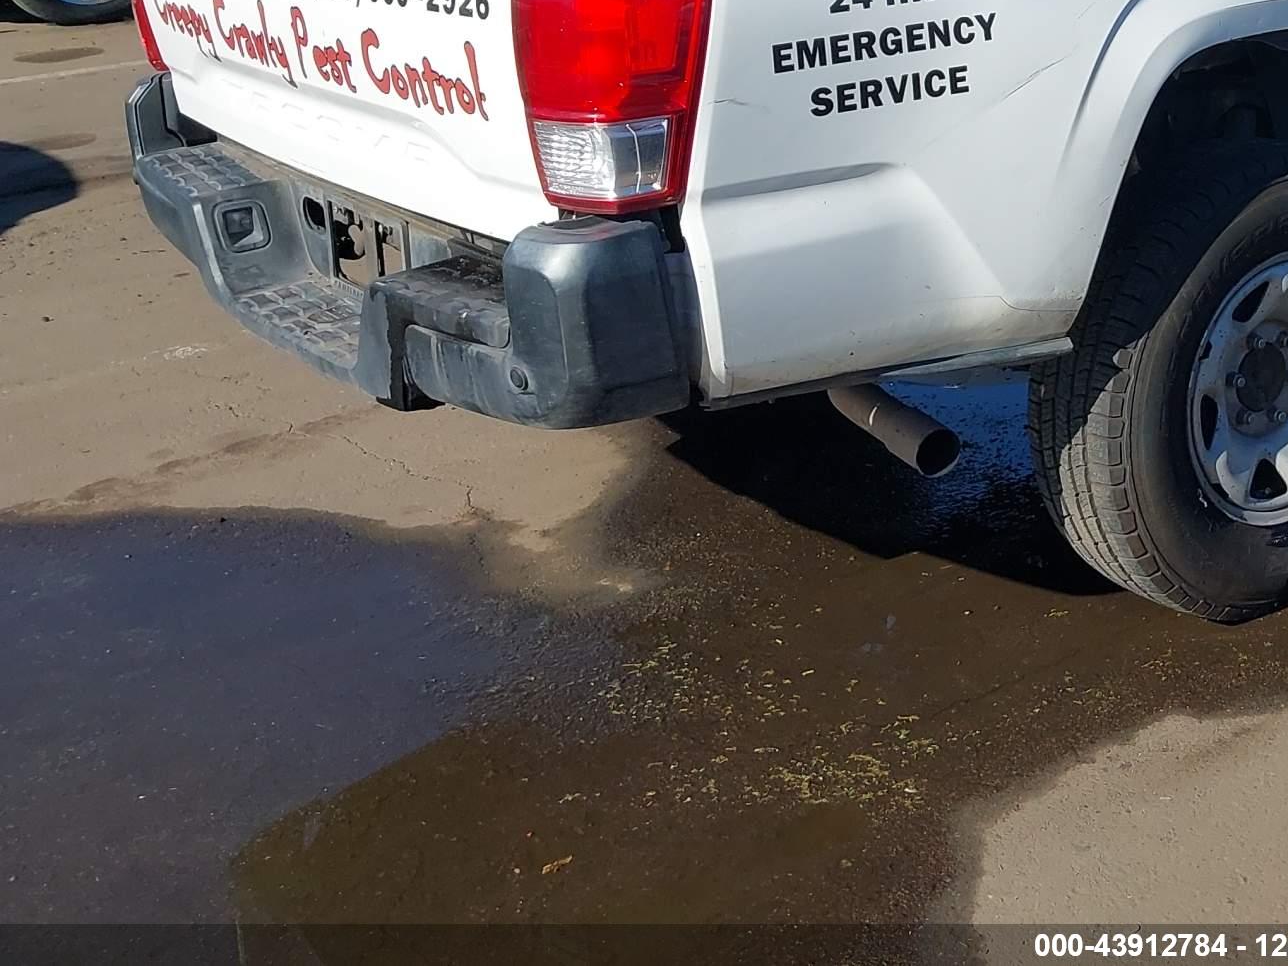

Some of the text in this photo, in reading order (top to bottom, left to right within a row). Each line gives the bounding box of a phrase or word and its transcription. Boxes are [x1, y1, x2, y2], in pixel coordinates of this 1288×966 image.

[289, 5, 357, 93] Pest
[360, 27, 490, 122] Control
[772, 12, 996, 74] EMERGENCY
[810, 65, 970, 116] SERVICE
